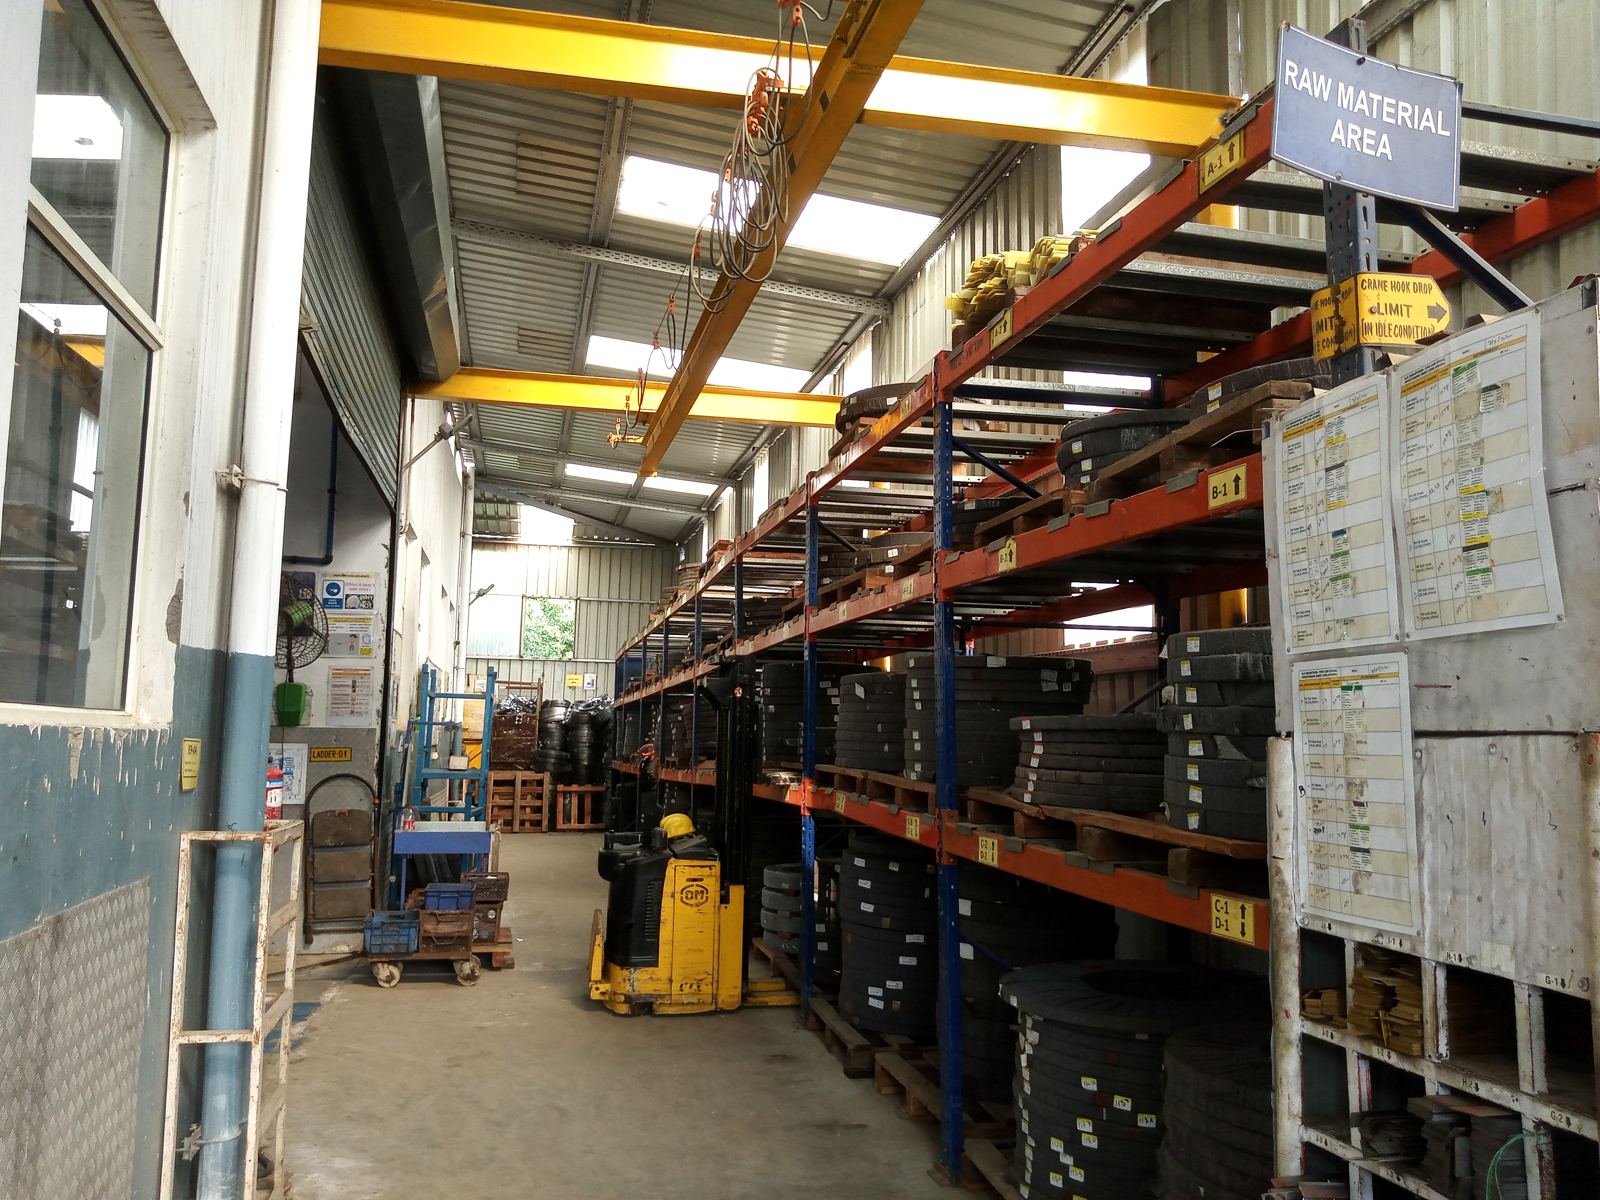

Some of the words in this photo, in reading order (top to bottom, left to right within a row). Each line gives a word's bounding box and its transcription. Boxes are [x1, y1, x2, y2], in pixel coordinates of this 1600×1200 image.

[1284, 59, 1332, 102] RAW
[1337, 81, 1450, 137] MATERIAL
[1330, 119, 1393, 161] AREA
[1207, 155, 1223, 177] A-1
[1360, 278, 1388, 292] CRANE
[1390, 279, 1411, 293] HOOK
[1412, 280, 1433, 295] DROP
[1376, 302, 1413, 318] LIMIT
[1212, 482, 1228, 500] B-1
[1214, 899, 1229, 915] C-1
[1214, 916, 1229, 932] D-1
[1446, 952, 1457, 961] H-1
[1545, 975, 1558, 986] G-1
[1550, 1110, 1563, 1123] G-2
